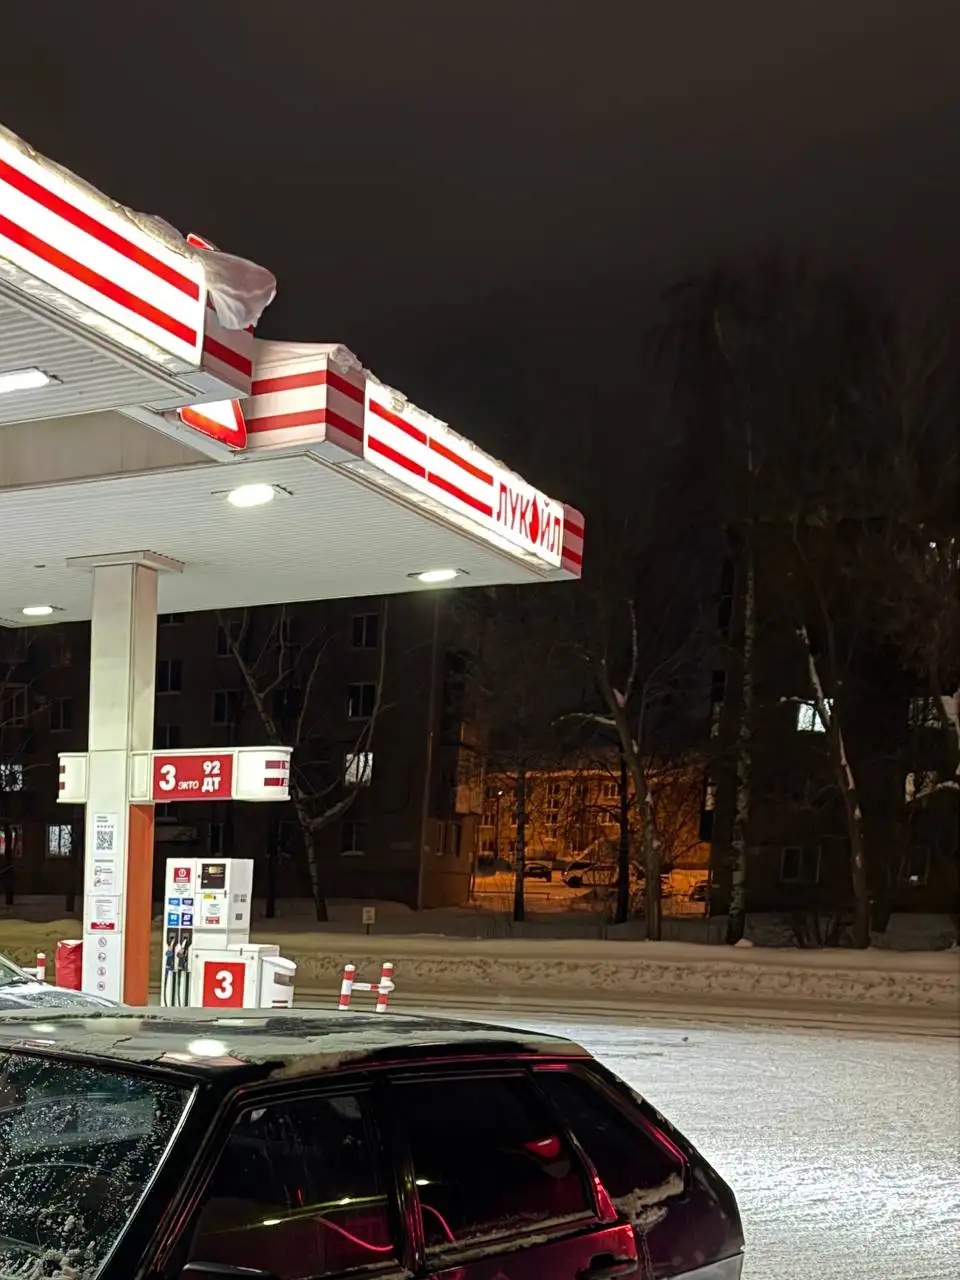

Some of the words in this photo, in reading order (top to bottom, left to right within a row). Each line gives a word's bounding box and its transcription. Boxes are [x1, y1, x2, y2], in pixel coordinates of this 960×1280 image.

[496, 481, 561, 556] ЛУКОЙЛ
[159, 764, 176, 791] 3
[202, 760, 221, 775] 92
[177, 780, 200, 790] ЭКТО
[201, 776, 221, 793] ДТ
[214, 969, 233, 1000] 3
